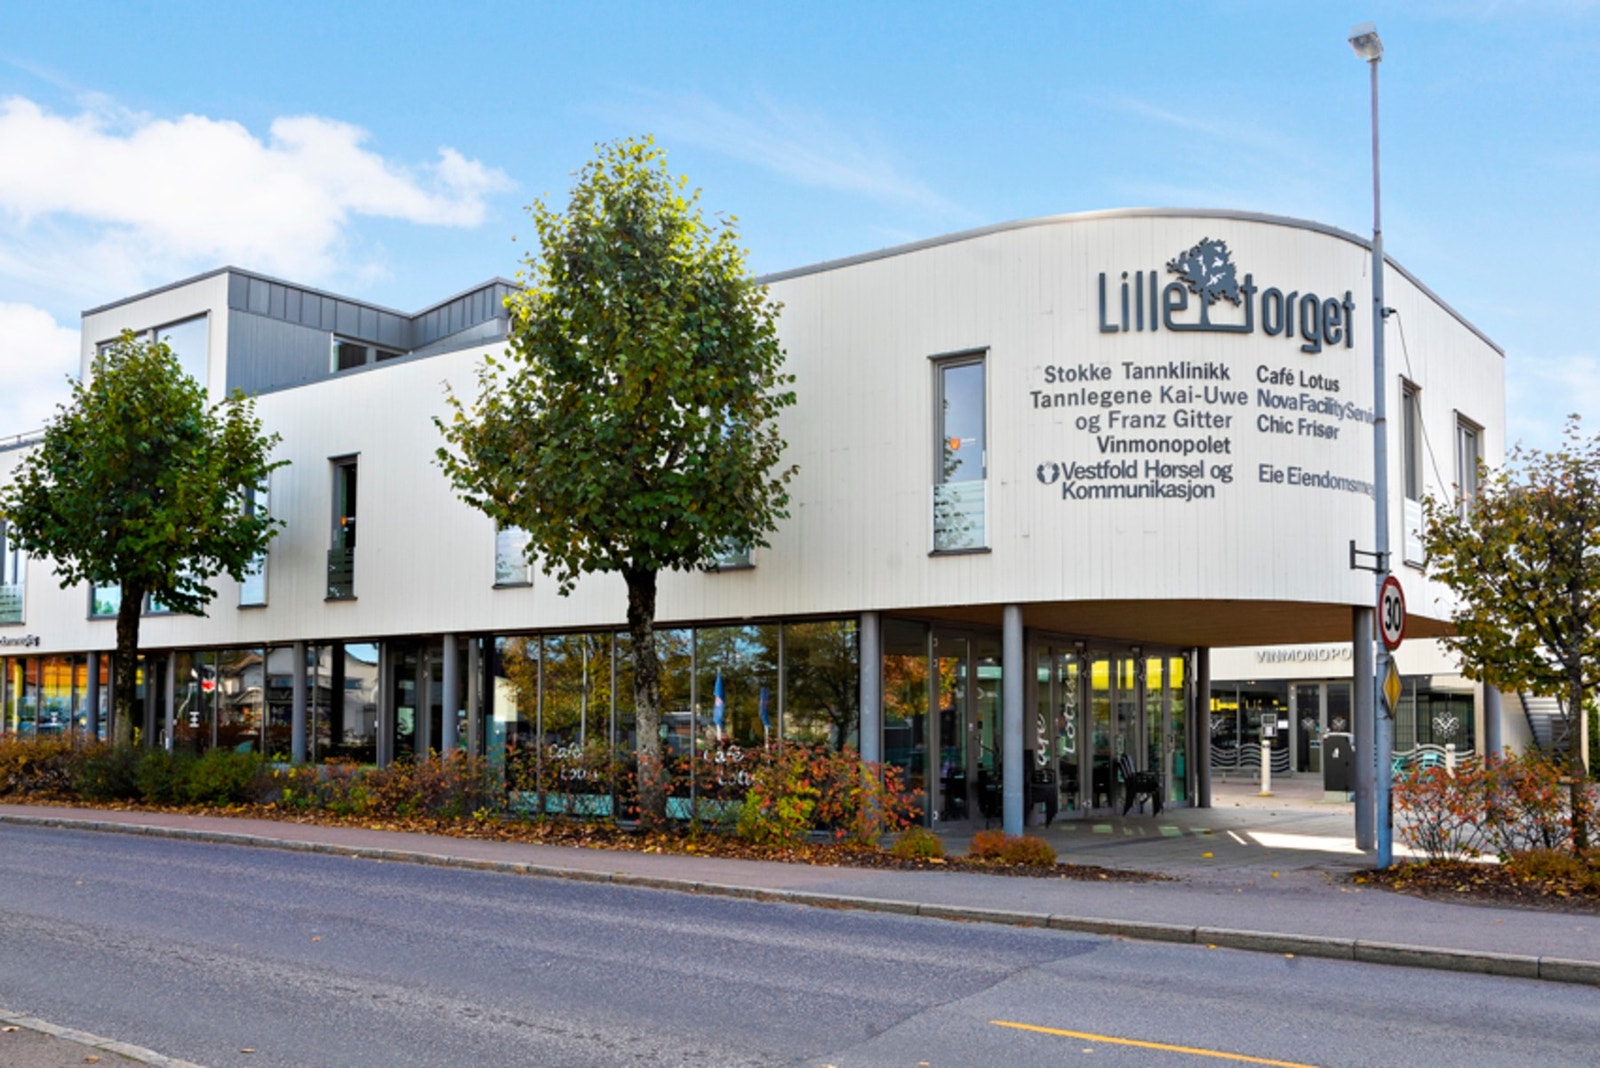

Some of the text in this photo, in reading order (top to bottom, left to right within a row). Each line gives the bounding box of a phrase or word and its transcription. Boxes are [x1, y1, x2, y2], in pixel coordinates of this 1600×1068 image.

[1099, 270, 1356, 354] Lilletorget
[1044, 361, 1231, 383] Stokke Tannklinikk
[1256, 364, 1340, 393] Café Lotus
[1030, 385, 1249, 409] Tannlegene Kai-Uwe
[1257, 387, 1298, 411] Nova
[1344, 400, 1375, 426] Servi
[1075, 408, 1233, 434] og Franz Gitter
[1256, 413, 1340, 440] Chic Frisør
[1097, 435, 1232, 456] Vinmonopolet
[1061, 459, 1233, 483] Vestfold Hørsel og
[1258, 463, 1285, 483] Eie
[1062, 479, 1216, 502] Kommunikasjon
[1384, 595, 1401, 632] 30
[1257, 648, 1353, 663] VINMONOPO
